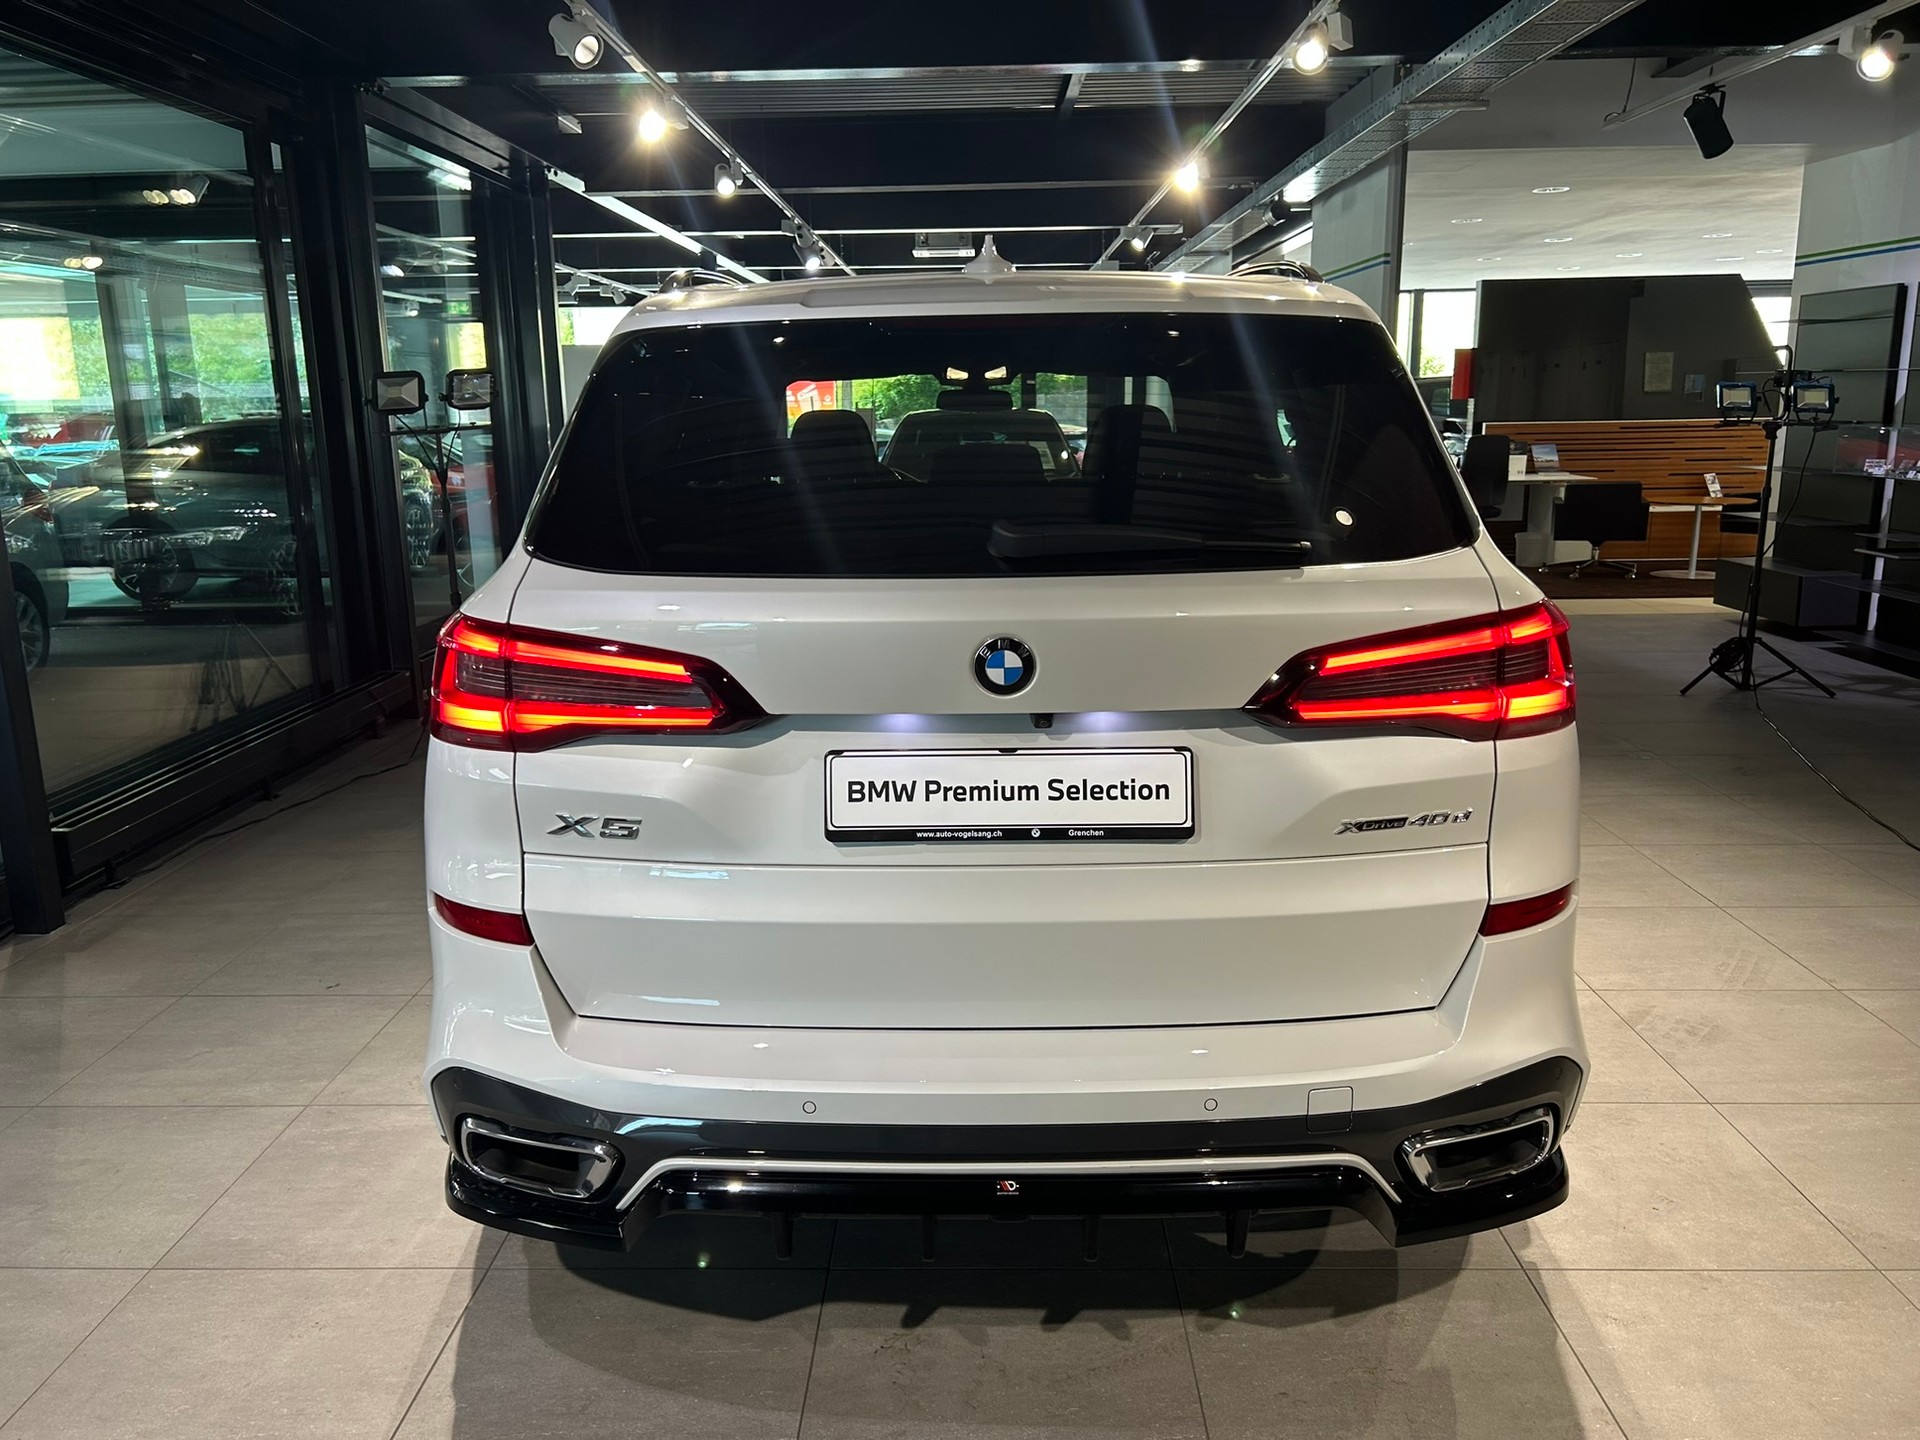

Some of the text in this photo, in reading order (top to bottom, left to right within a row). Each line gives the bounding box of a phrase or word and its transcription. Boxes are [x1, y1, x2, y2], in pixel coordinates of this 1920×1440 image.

[847, 778, 1170, 803] BMW Premium Selection
[546, 813, 642, 840] X5
[916, 830, 1003, 838] www.auto-vogelsang.ch
[1068, 829, 1104, 837] Grenchen
